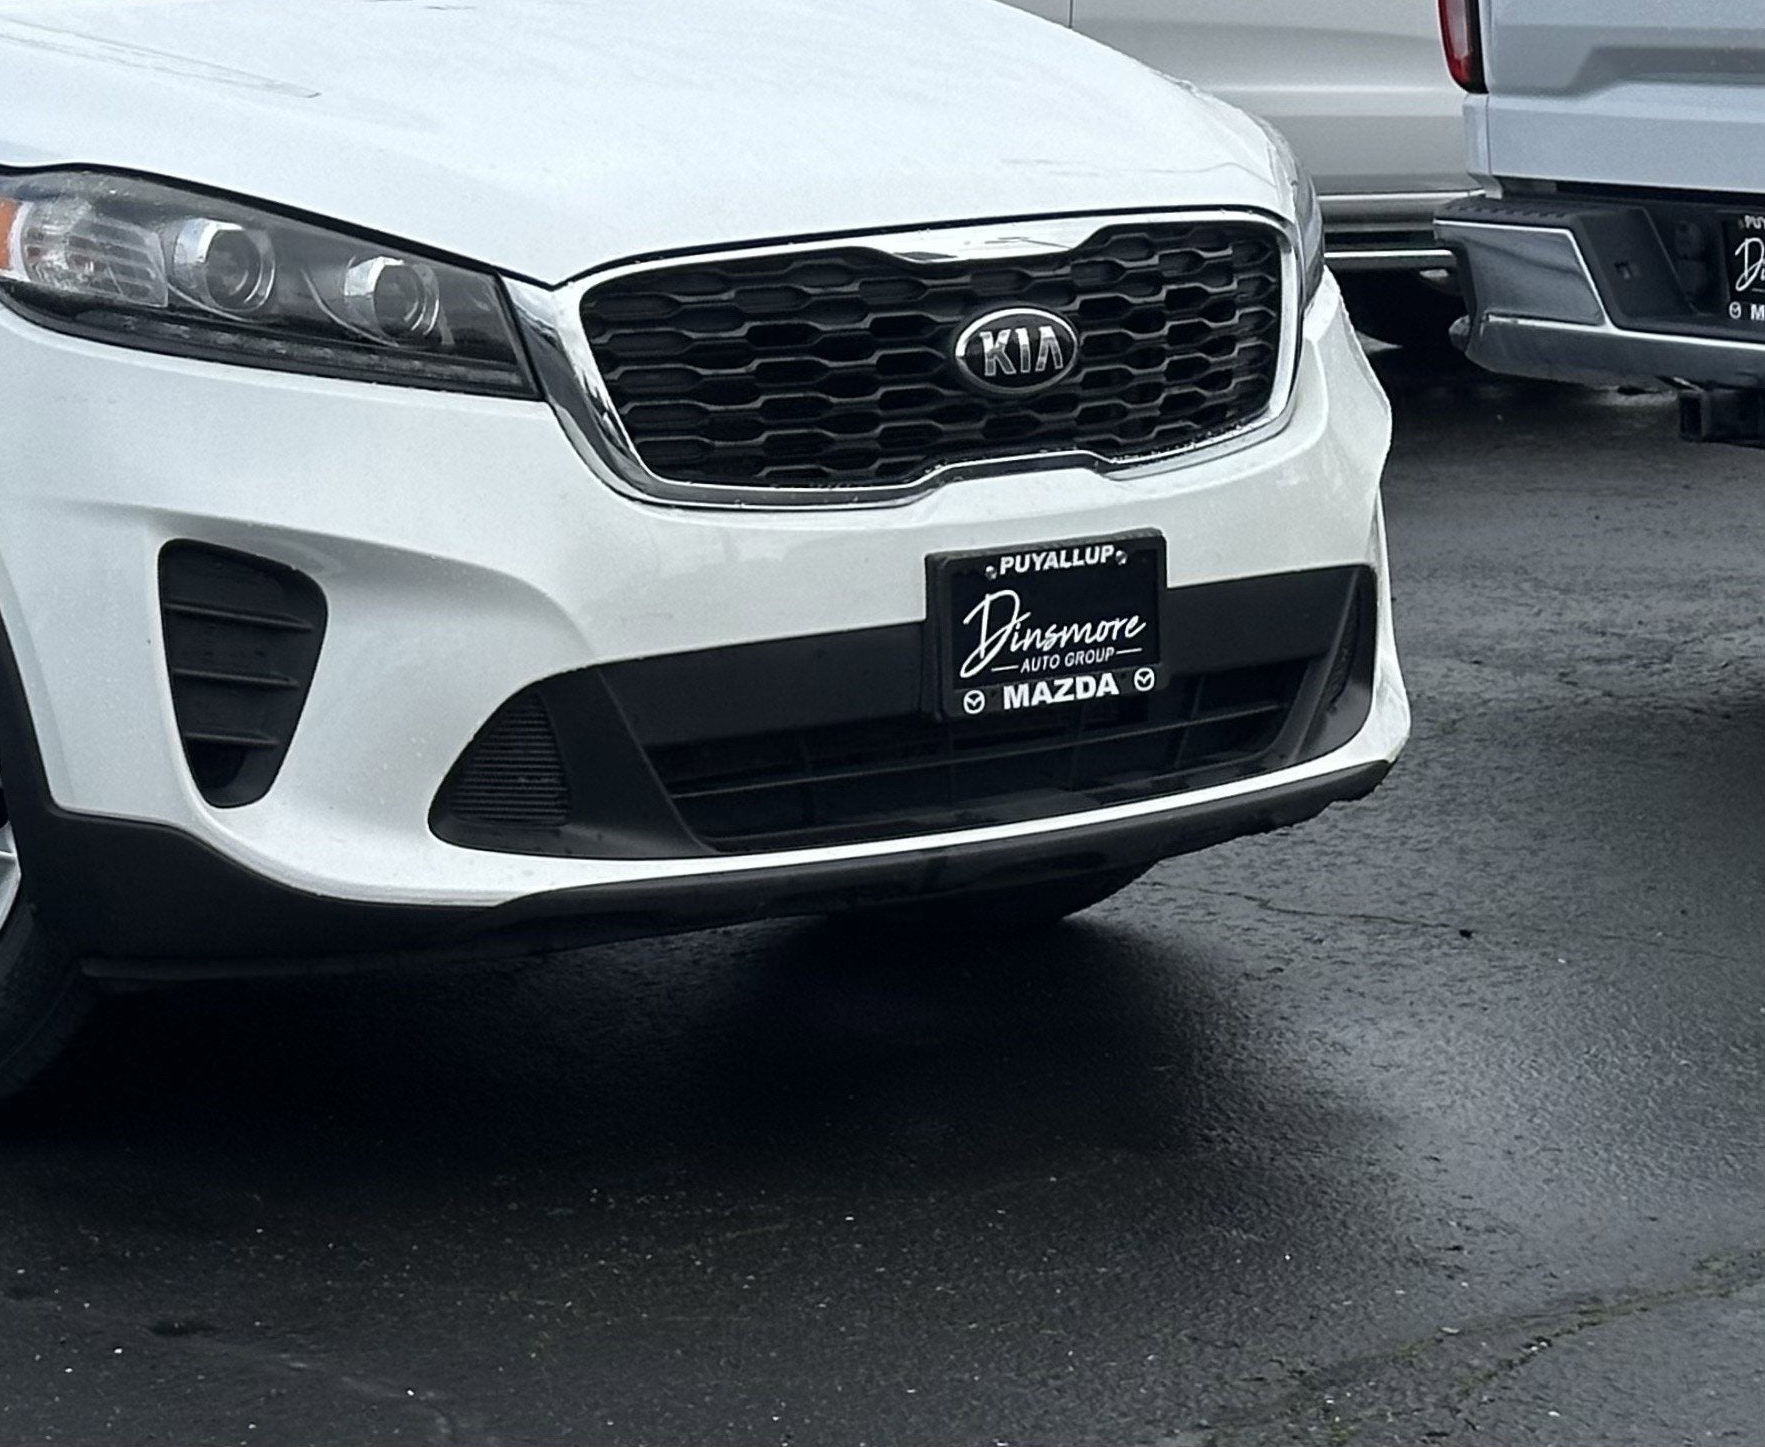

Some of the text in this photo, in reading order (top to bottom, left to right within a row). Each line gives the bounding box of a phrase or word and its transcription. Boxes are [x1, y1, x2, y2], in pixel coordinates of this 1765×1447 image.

[979, 326, 1064, 377] KIA
[999, 544, 1115, 575] PUYALLUP
[959, 589, 1147, 679] Dinsmore
[1020, 646, 1116, 674] AUTO GROUP
[1003, 672, 1120, 710] MAZDA
